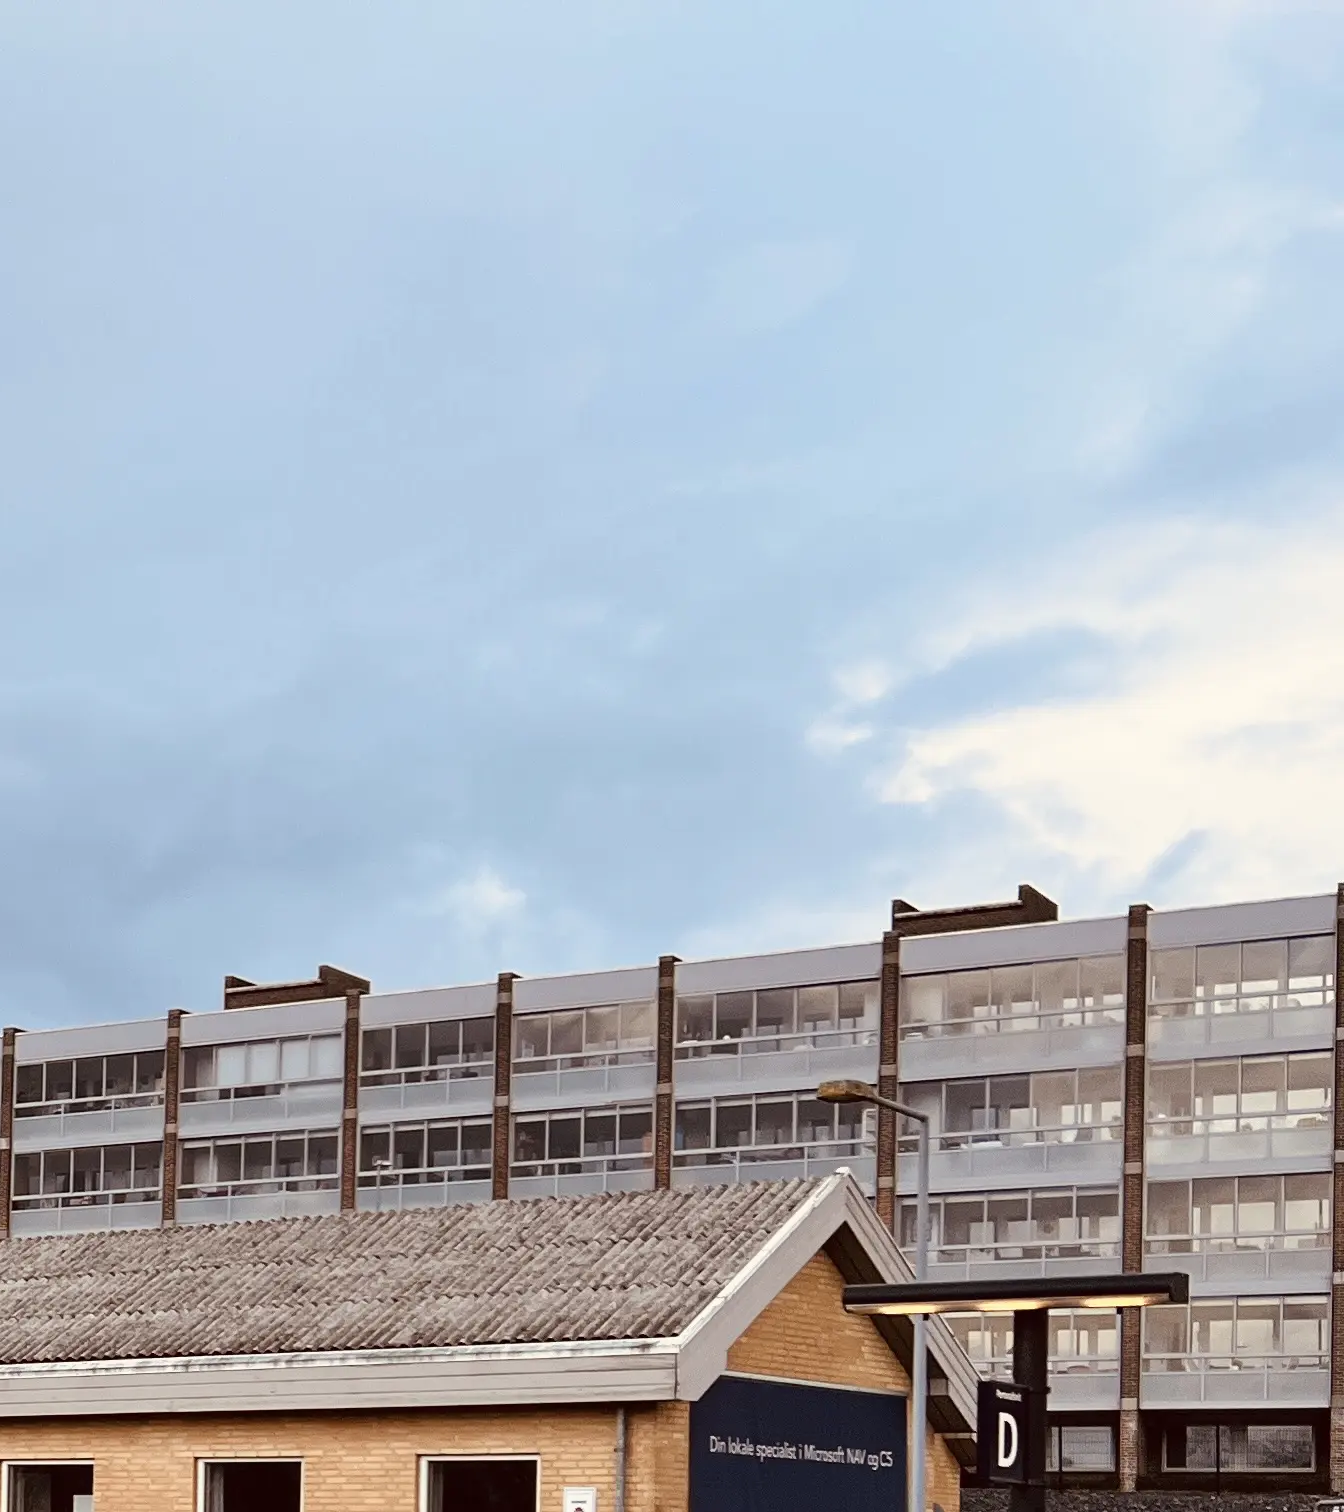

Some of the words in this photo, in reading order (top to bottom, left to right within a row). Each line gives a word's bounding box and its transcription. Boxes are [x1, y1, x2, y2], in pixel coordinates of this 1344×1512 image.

[709, 1435, 726, 1453] Din
[728, 1436, 754, 1456] lokale
[756, 1441, 796, 1463] specialist
[803, 1443, 845, 1464] Microsoft
[846, 1447, 866, 1465] NAV
[867, 1454, 880, 1471] og
[998, 1411, 1019, 1468] D
